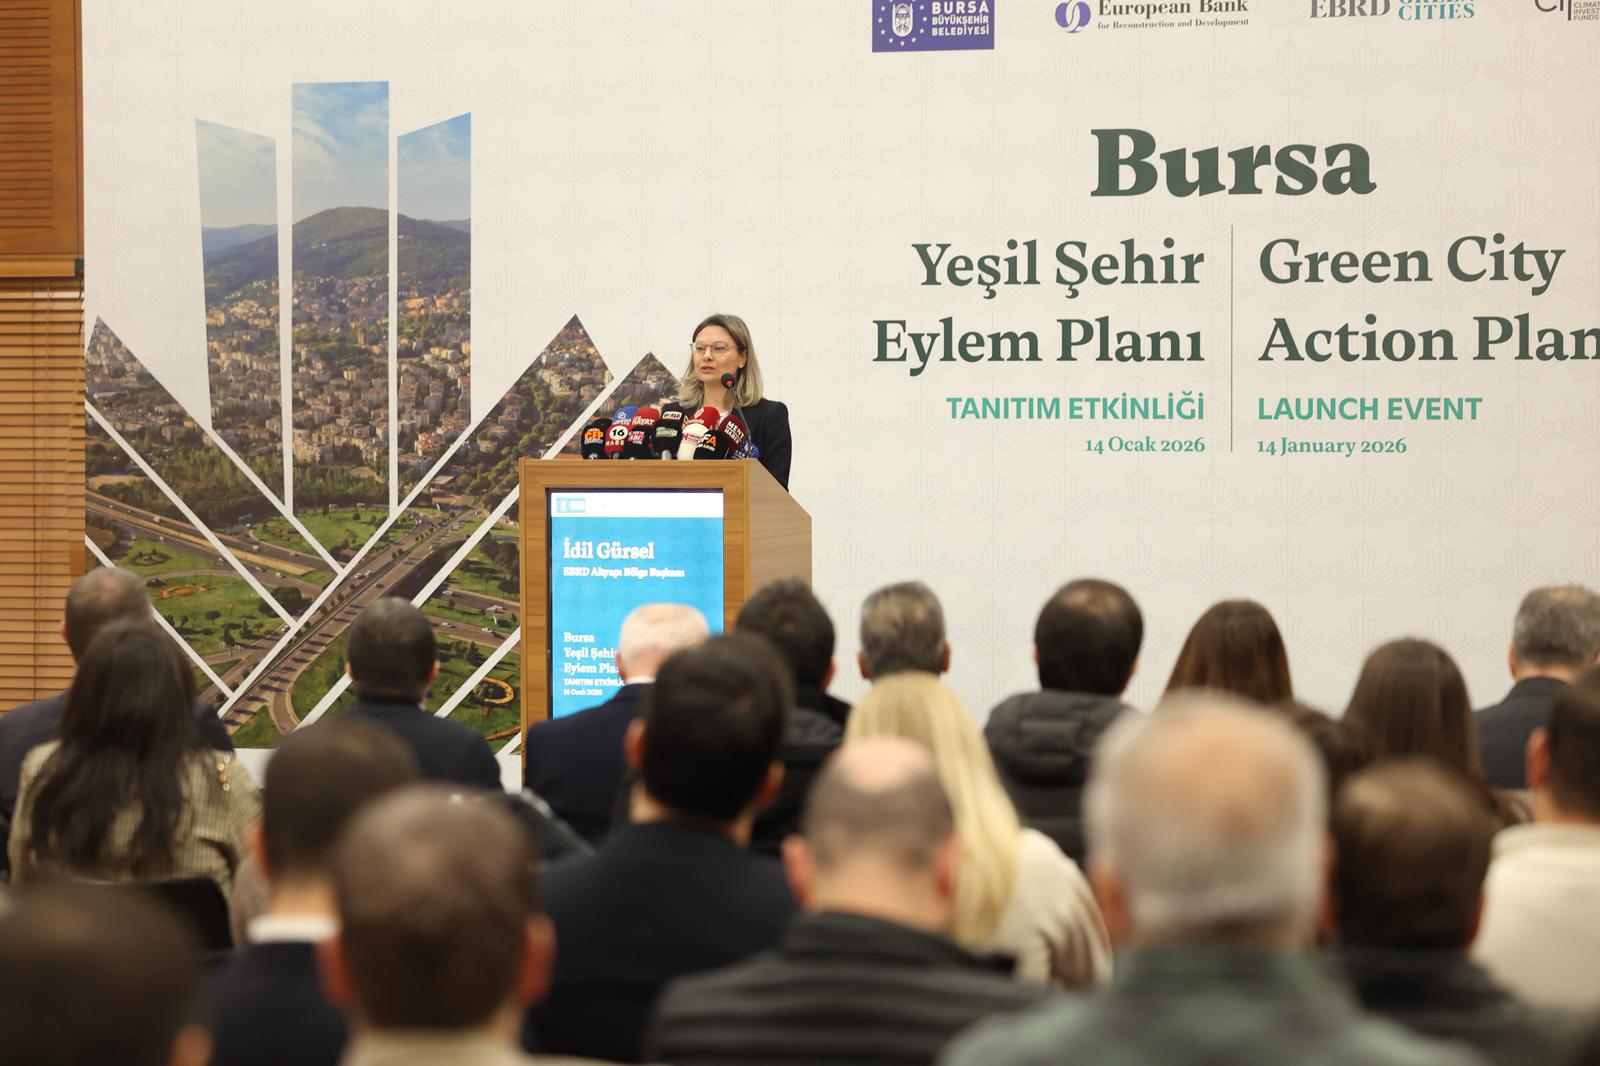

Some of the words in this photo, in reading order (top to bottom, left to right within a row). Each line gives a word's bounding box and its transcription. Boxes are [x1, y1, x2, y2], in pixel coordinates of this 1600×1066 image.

[932, 1, 989, 14] BURSA
[1098, 0, 1191, 19] European
[1199, 0, 1249, 12] Bank
[1310, 0, 1391, 18] EBRD
[1398, 3, 1475, 20] CITIES
[932, 14, 989, 26] BÜYÜKŞEHİR
[1097, 21, 1109, 29] for
[1113, 20, 1175, 29] Reconstruction
[1177, 20, 1193, 28] and
[1195, 19, 1249, 28] Development
[932, 25, 989, 36] BELEDİYESİ
[1090, 128, 1377, 197] Bursa
[911, 239, 1041, 299] Yeşil
[1055, 237, 1205, 299] Şehir
[1259, 238, 1433, 284] Green
[1447, 233, 1566, 296] City
[872, 316, 1043, 377] Eylem
[1056, 315, 1205, 362] Planı
[1258, 313, 1458, 362] Action
[1473, 312, 1600, 361] Plan
[946, 397, 1061, 420] TANITIM
[1069, 390, 1205, 420] ETKİNLİĞİ
[1258, 397, 1379, 421] LAUNCH
[1387, 397, 1483, 420] EVENT
[611, 429, 625, 439] 16
[1086, 439, 1105, 455] 14
[1108, 436, 1156, 453] Ocak
[1160, 436, 1206, 453] 2026
[1257, 439, 1277, 455] 14
[1280, 437, 1356, 457] January
[1361, 438, 1407, 453] 2026
[563, 537, 594, 559] İdil
[596, 541, 656, 559] Gürsel
[563, 632, 595, 643] Bursa
[563, 647, 589, 660] Yeşil
[563, 662, 597, 675] Eylem
